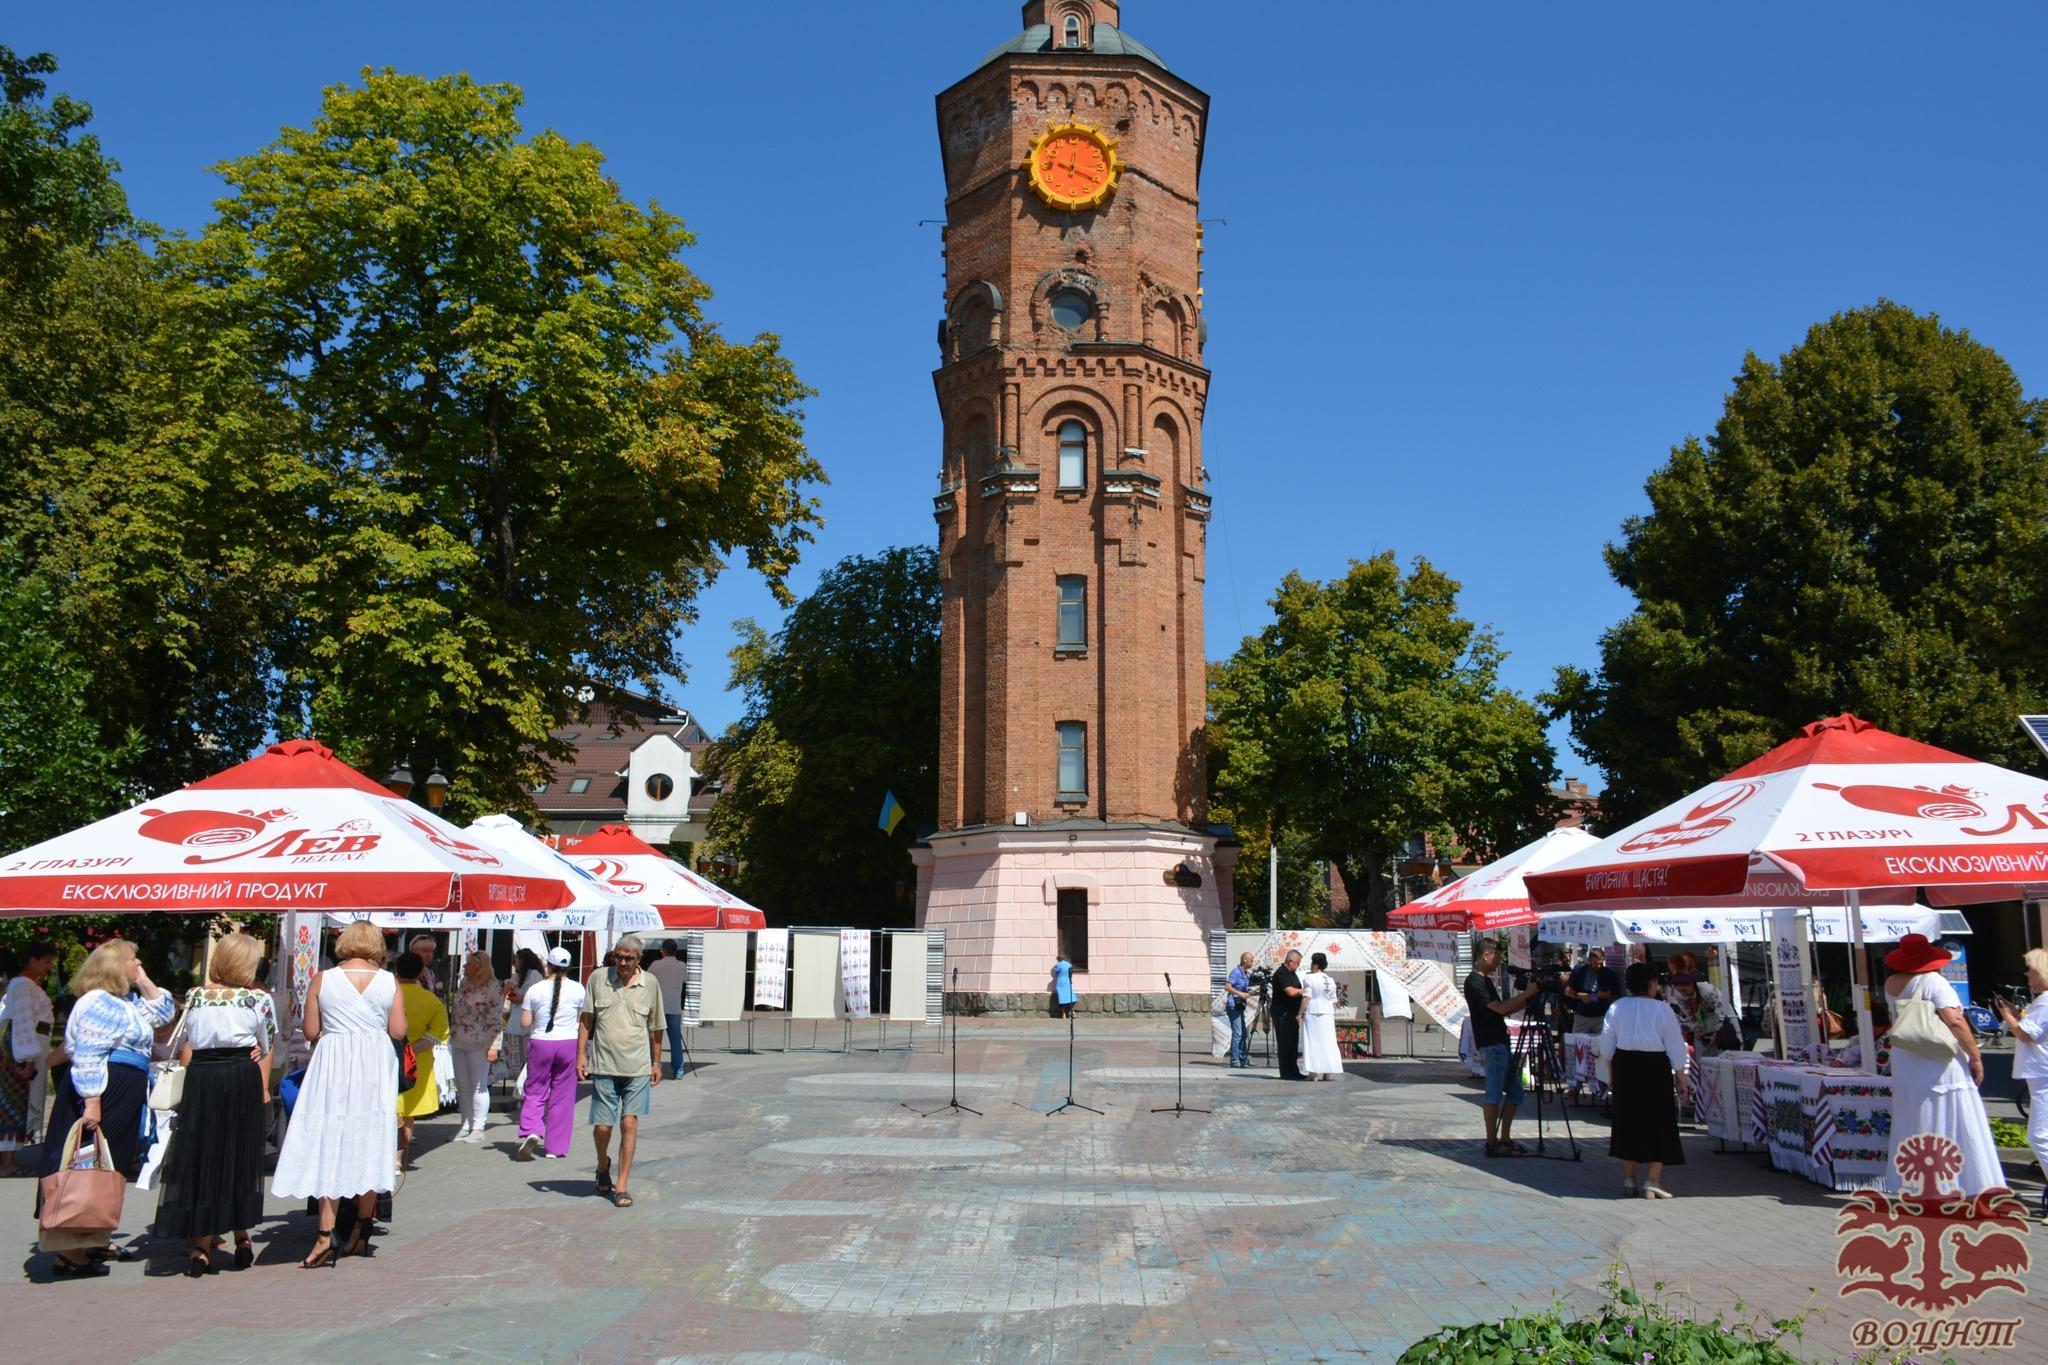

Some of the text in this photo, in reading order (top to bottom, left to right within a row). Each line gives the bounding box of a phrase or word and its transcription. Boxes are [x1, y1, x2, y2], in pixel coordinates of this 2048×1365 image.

[1796, 829, 1914, 842] 2 ГЛАЗУРІ
[6, 857, 133, 871] 2 ГЛАЗУРІ
[290, 852, 369, 865] DELUXE
[1884, 850, 2048, 875] ЕКСКЛЮЗИВНИЙ
[1585, 864, 1671, 894] ВИРОБНИК ЩАСТЯ!
[62, 880, 328, 901] ЕКСКЛЮЗИВНИЙ ПРОДУКТ
[493, 913, 515, 925] №1
[564, 914, 587, 926] №1
[1660, 926, 1683, 937] №1
[1734, 924, 1758, 935] №1
